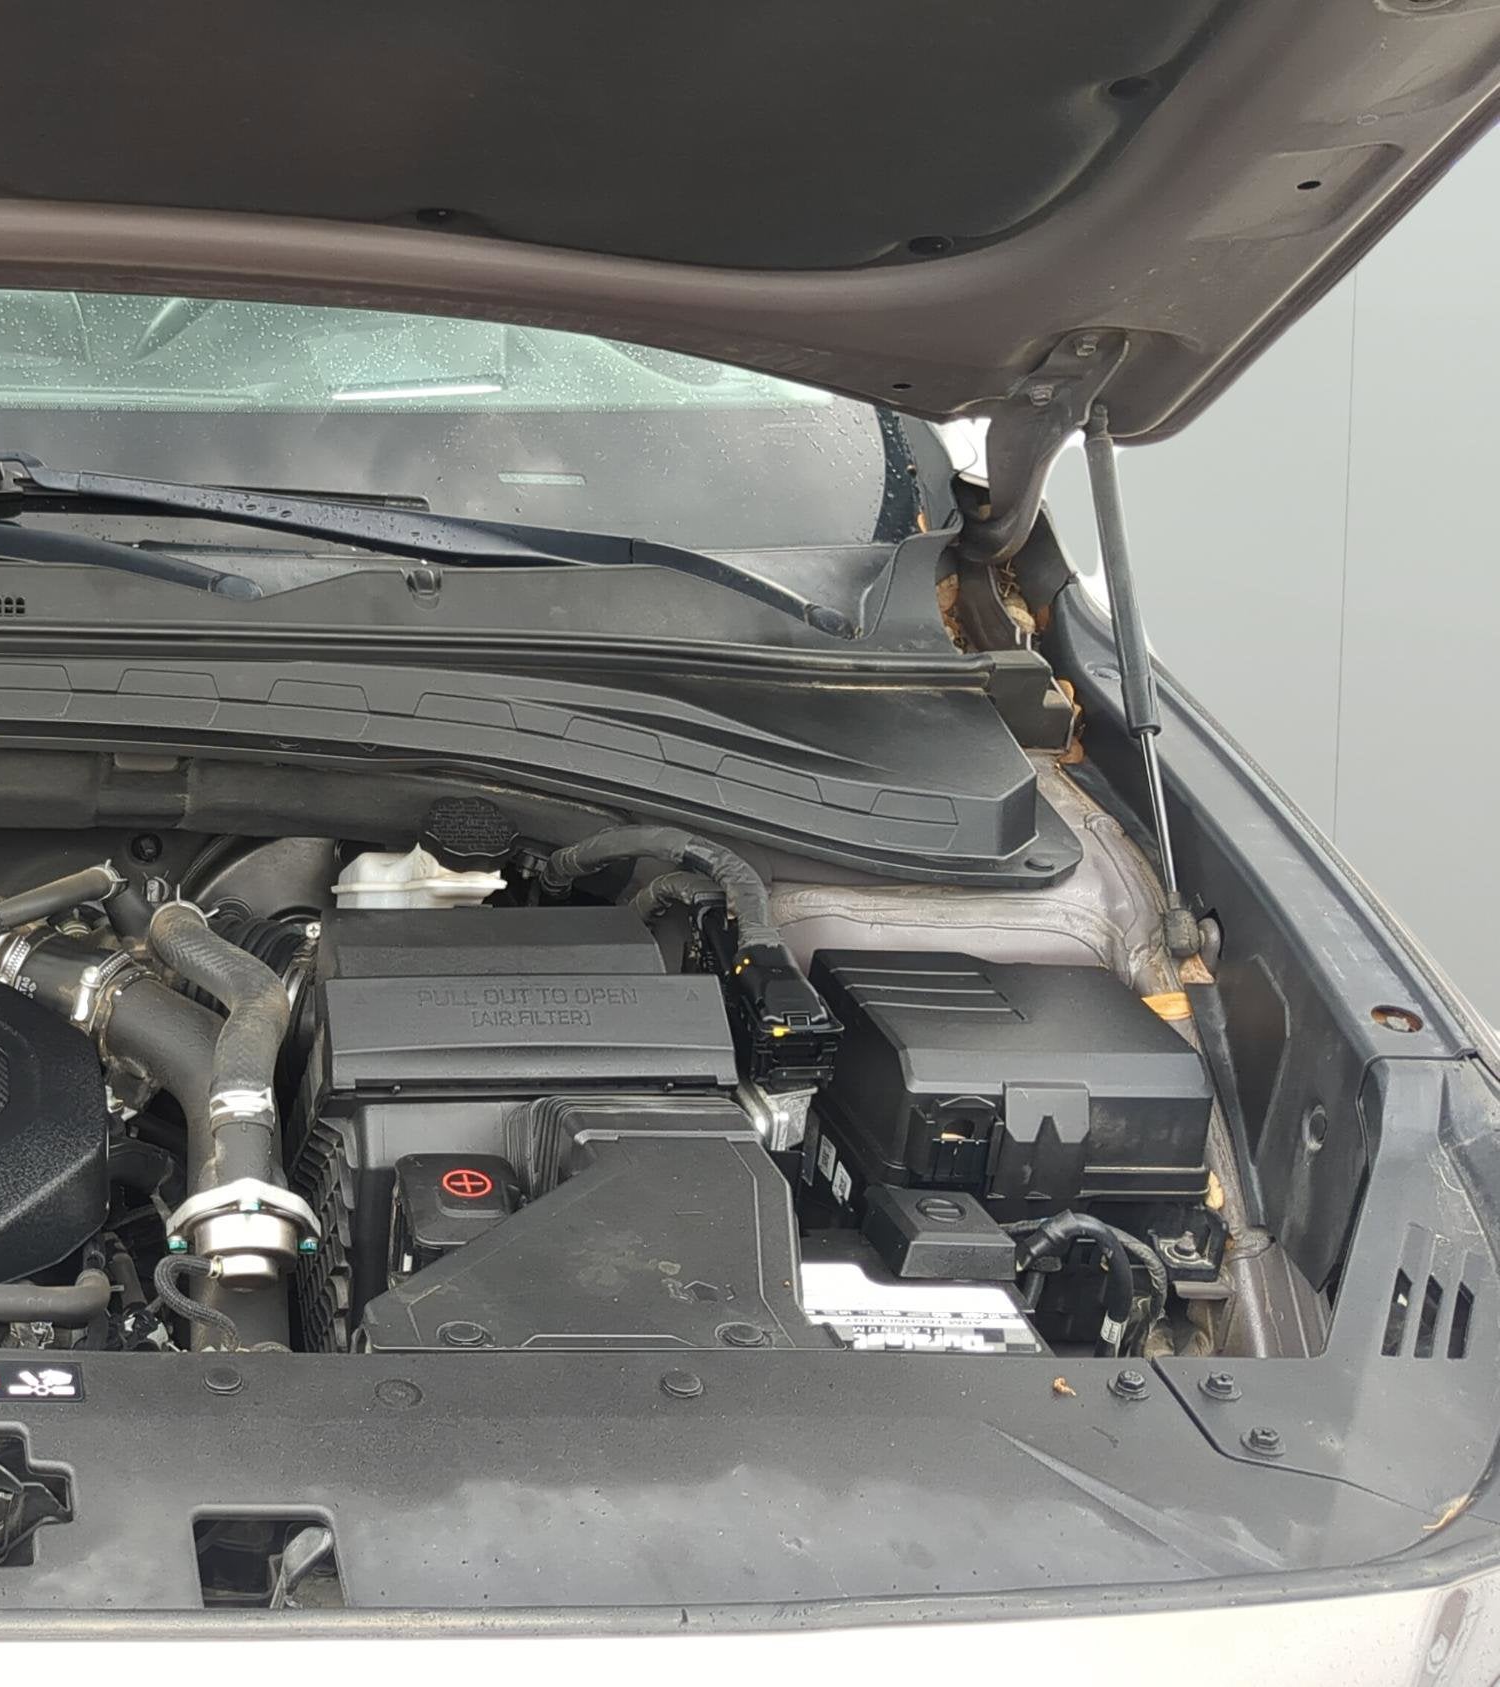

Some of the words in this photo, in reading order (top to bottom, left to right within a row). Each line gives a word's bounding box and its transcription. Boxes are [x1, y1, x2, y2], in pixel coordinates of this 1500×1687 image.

[417, 989, 478, 1007] PULL
[483, 988, 533, 1006] OUT
[536, 987, 568, 1005] TO
[574, 987, 639, 1005] OPEN
[852, 1326, 944, 1335] PLATINUM
[853, 1333, 995, 1351] Duralast
